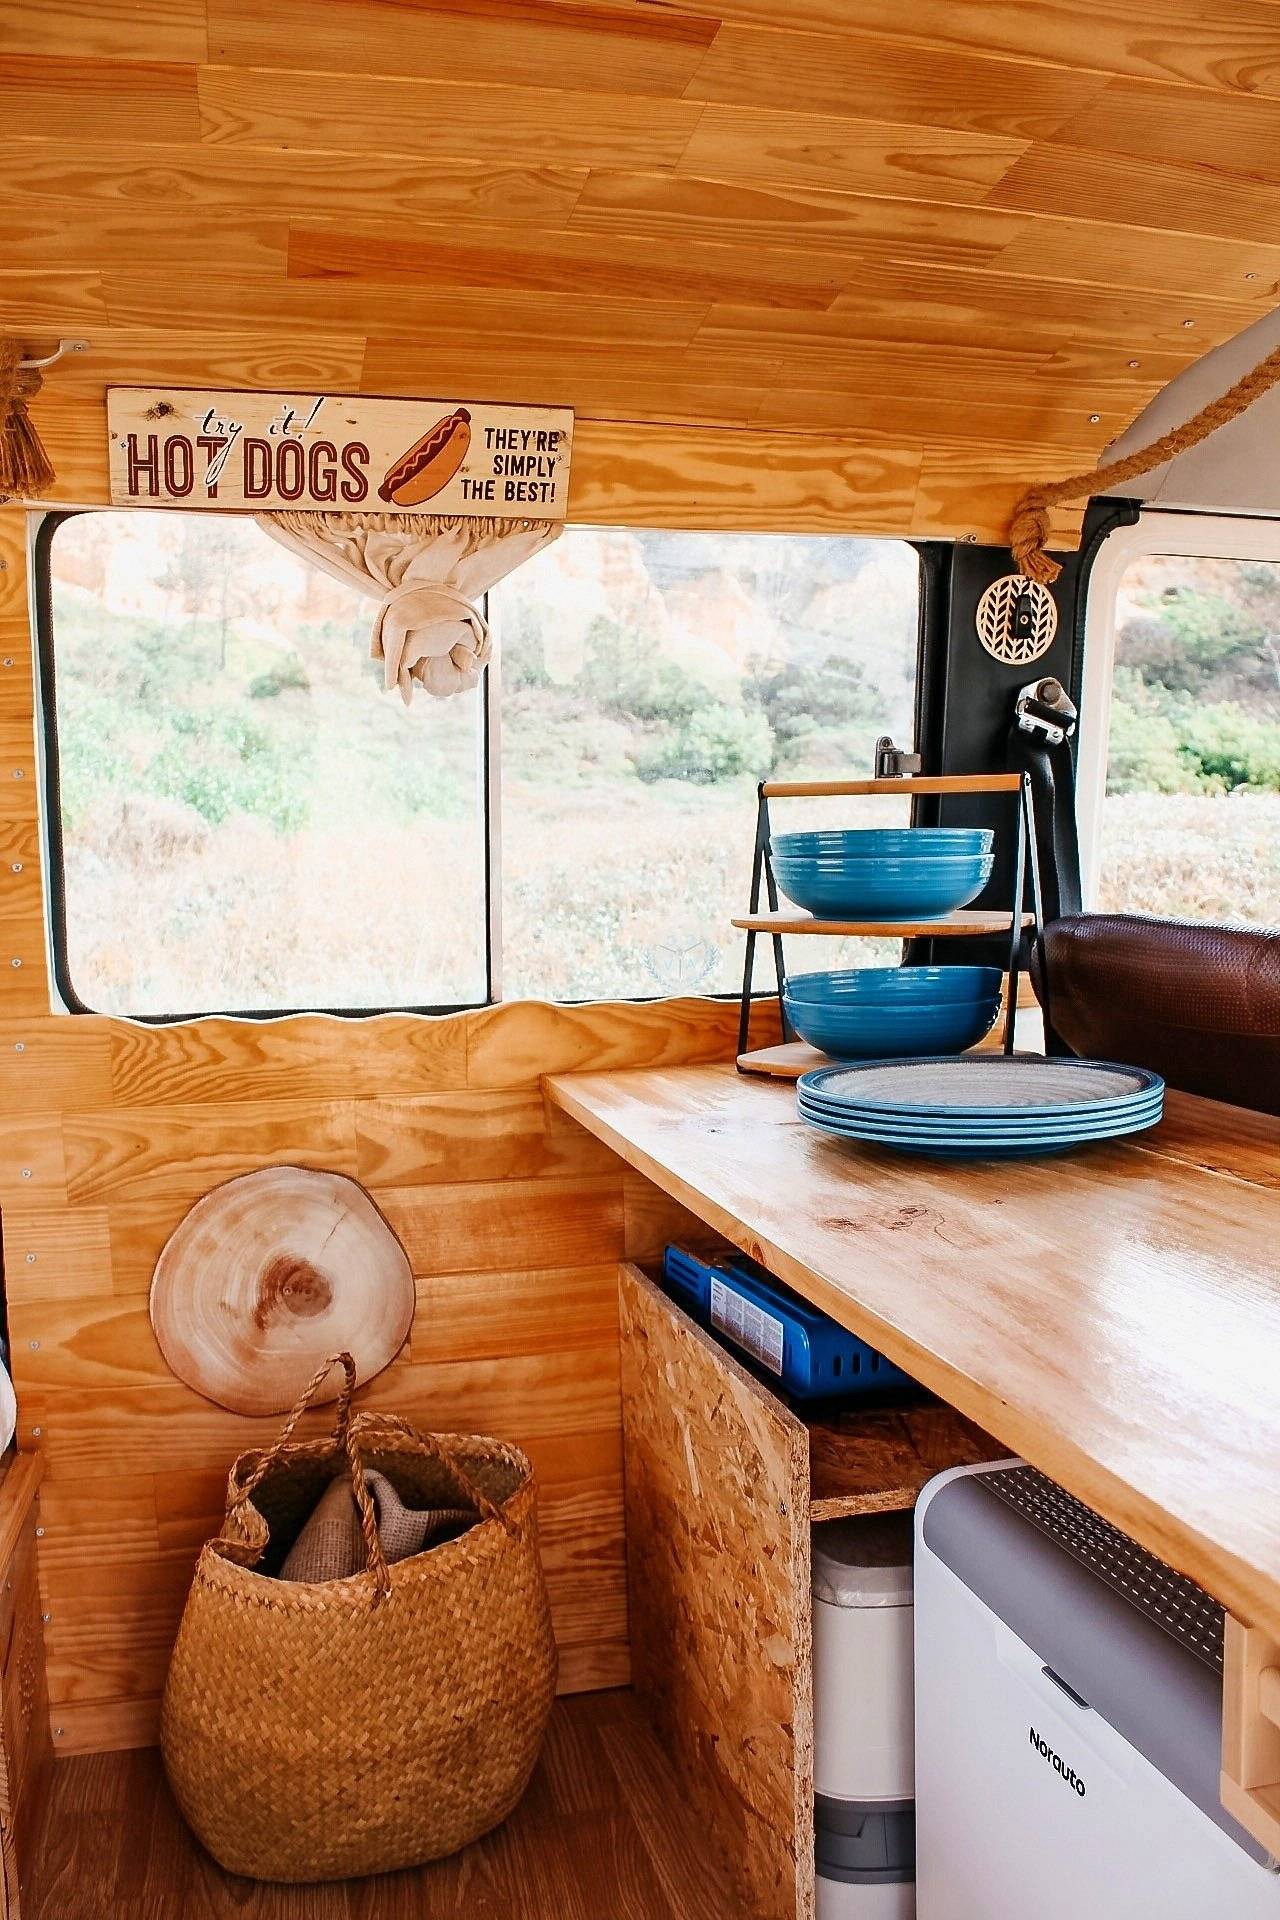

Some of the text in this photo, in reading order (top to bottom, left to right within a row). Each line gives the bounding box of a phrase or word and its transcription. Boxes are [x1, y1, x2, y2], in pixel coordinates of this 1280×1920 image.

[195, 396, 325, 485] try it!
[484, 427, 560, 452] THEY'RE
[127, 433, 370, 502] HOT DOGS
[493, 454, 556, 478] SIMPLY
[461, 478, 556, 503] THE BEST!
[1029, 1726, 1086, 1797] Norauto
